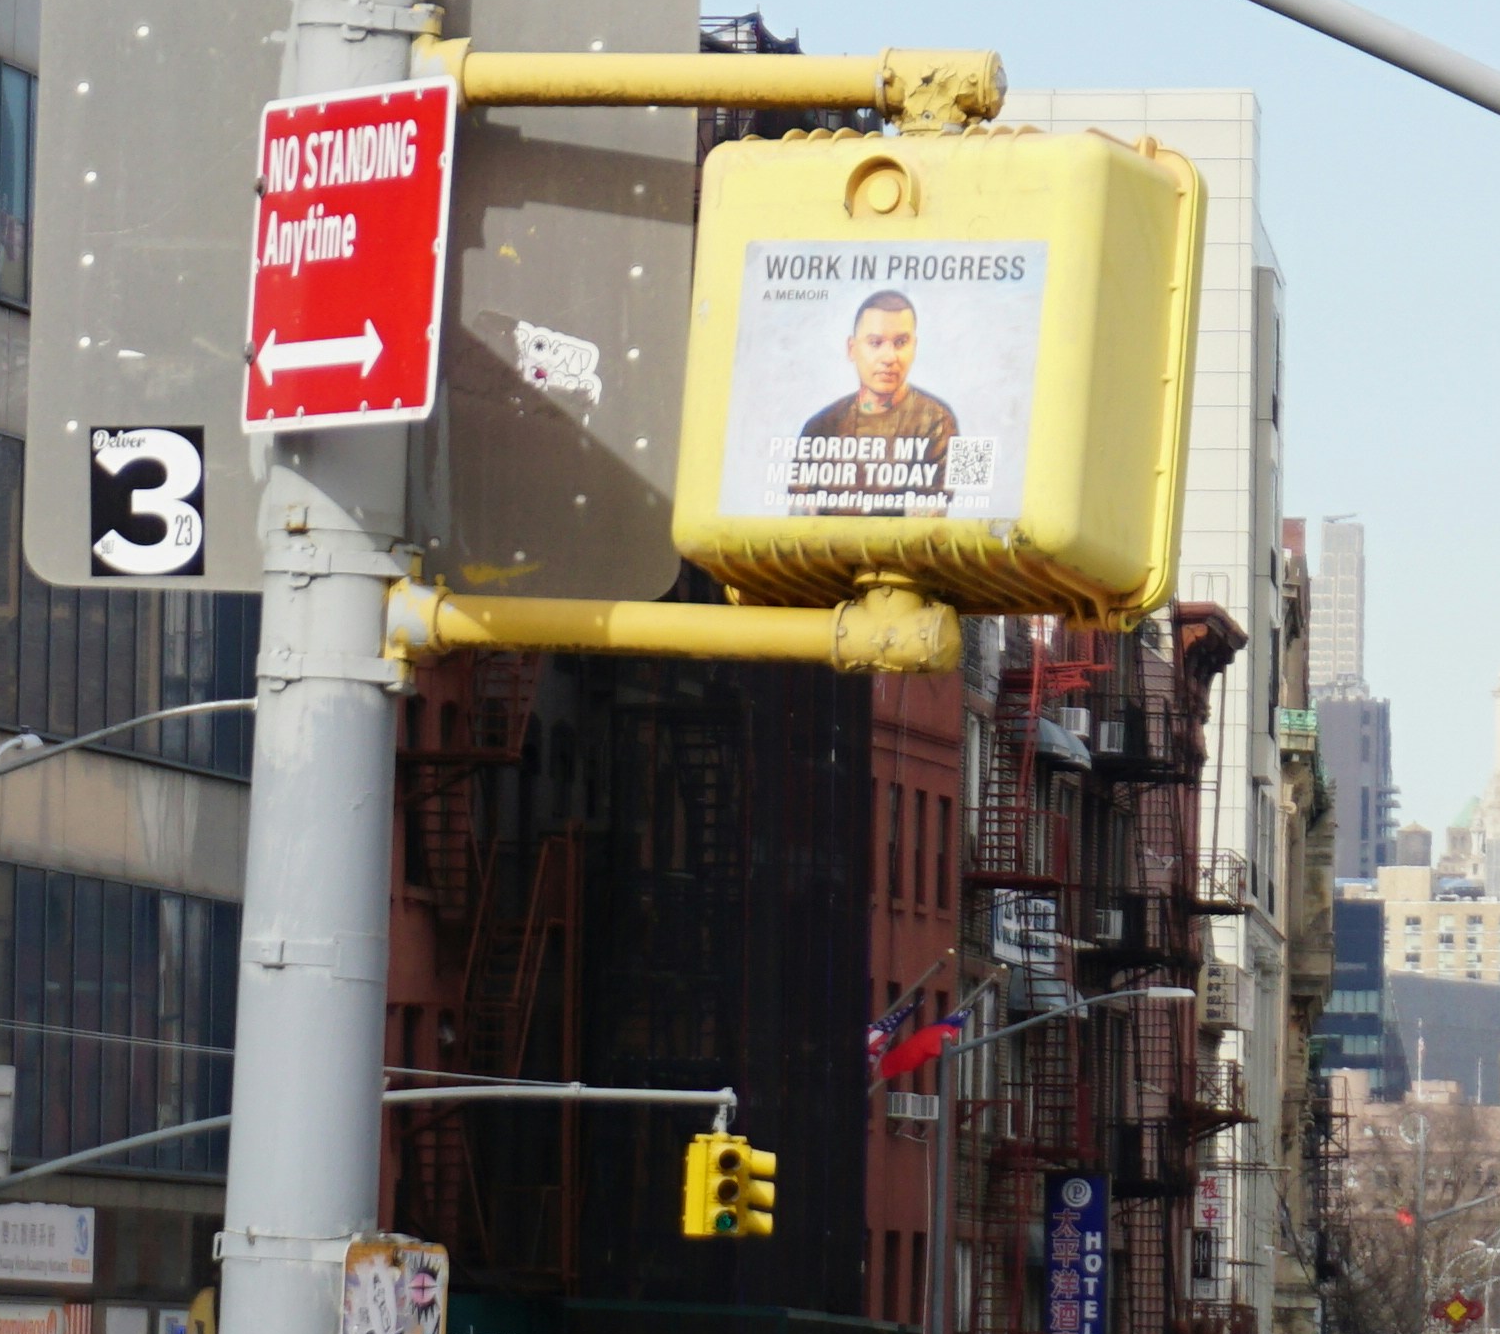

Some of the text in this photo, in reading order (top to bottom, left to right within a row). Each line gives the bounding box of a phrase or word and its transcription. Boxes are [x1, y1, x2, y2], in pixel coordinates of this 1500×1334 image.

[267, 119, 418, 194] NO STANDING
[262, 203, 357, 277] Anytime
[765, 253, 1026, 282] WORK IN PROGRESS
[763, 289, 830, 301] A MEMOIR
[769, 436, 930, 460] PREORDER MY
[766, 463, 938, 487] MEMOIR TODAY
[93, 428, 203, 575] 3
[764, 491, 990, 514] DevonRodriguezBook.com
[174, 515, 193, 546] 23
